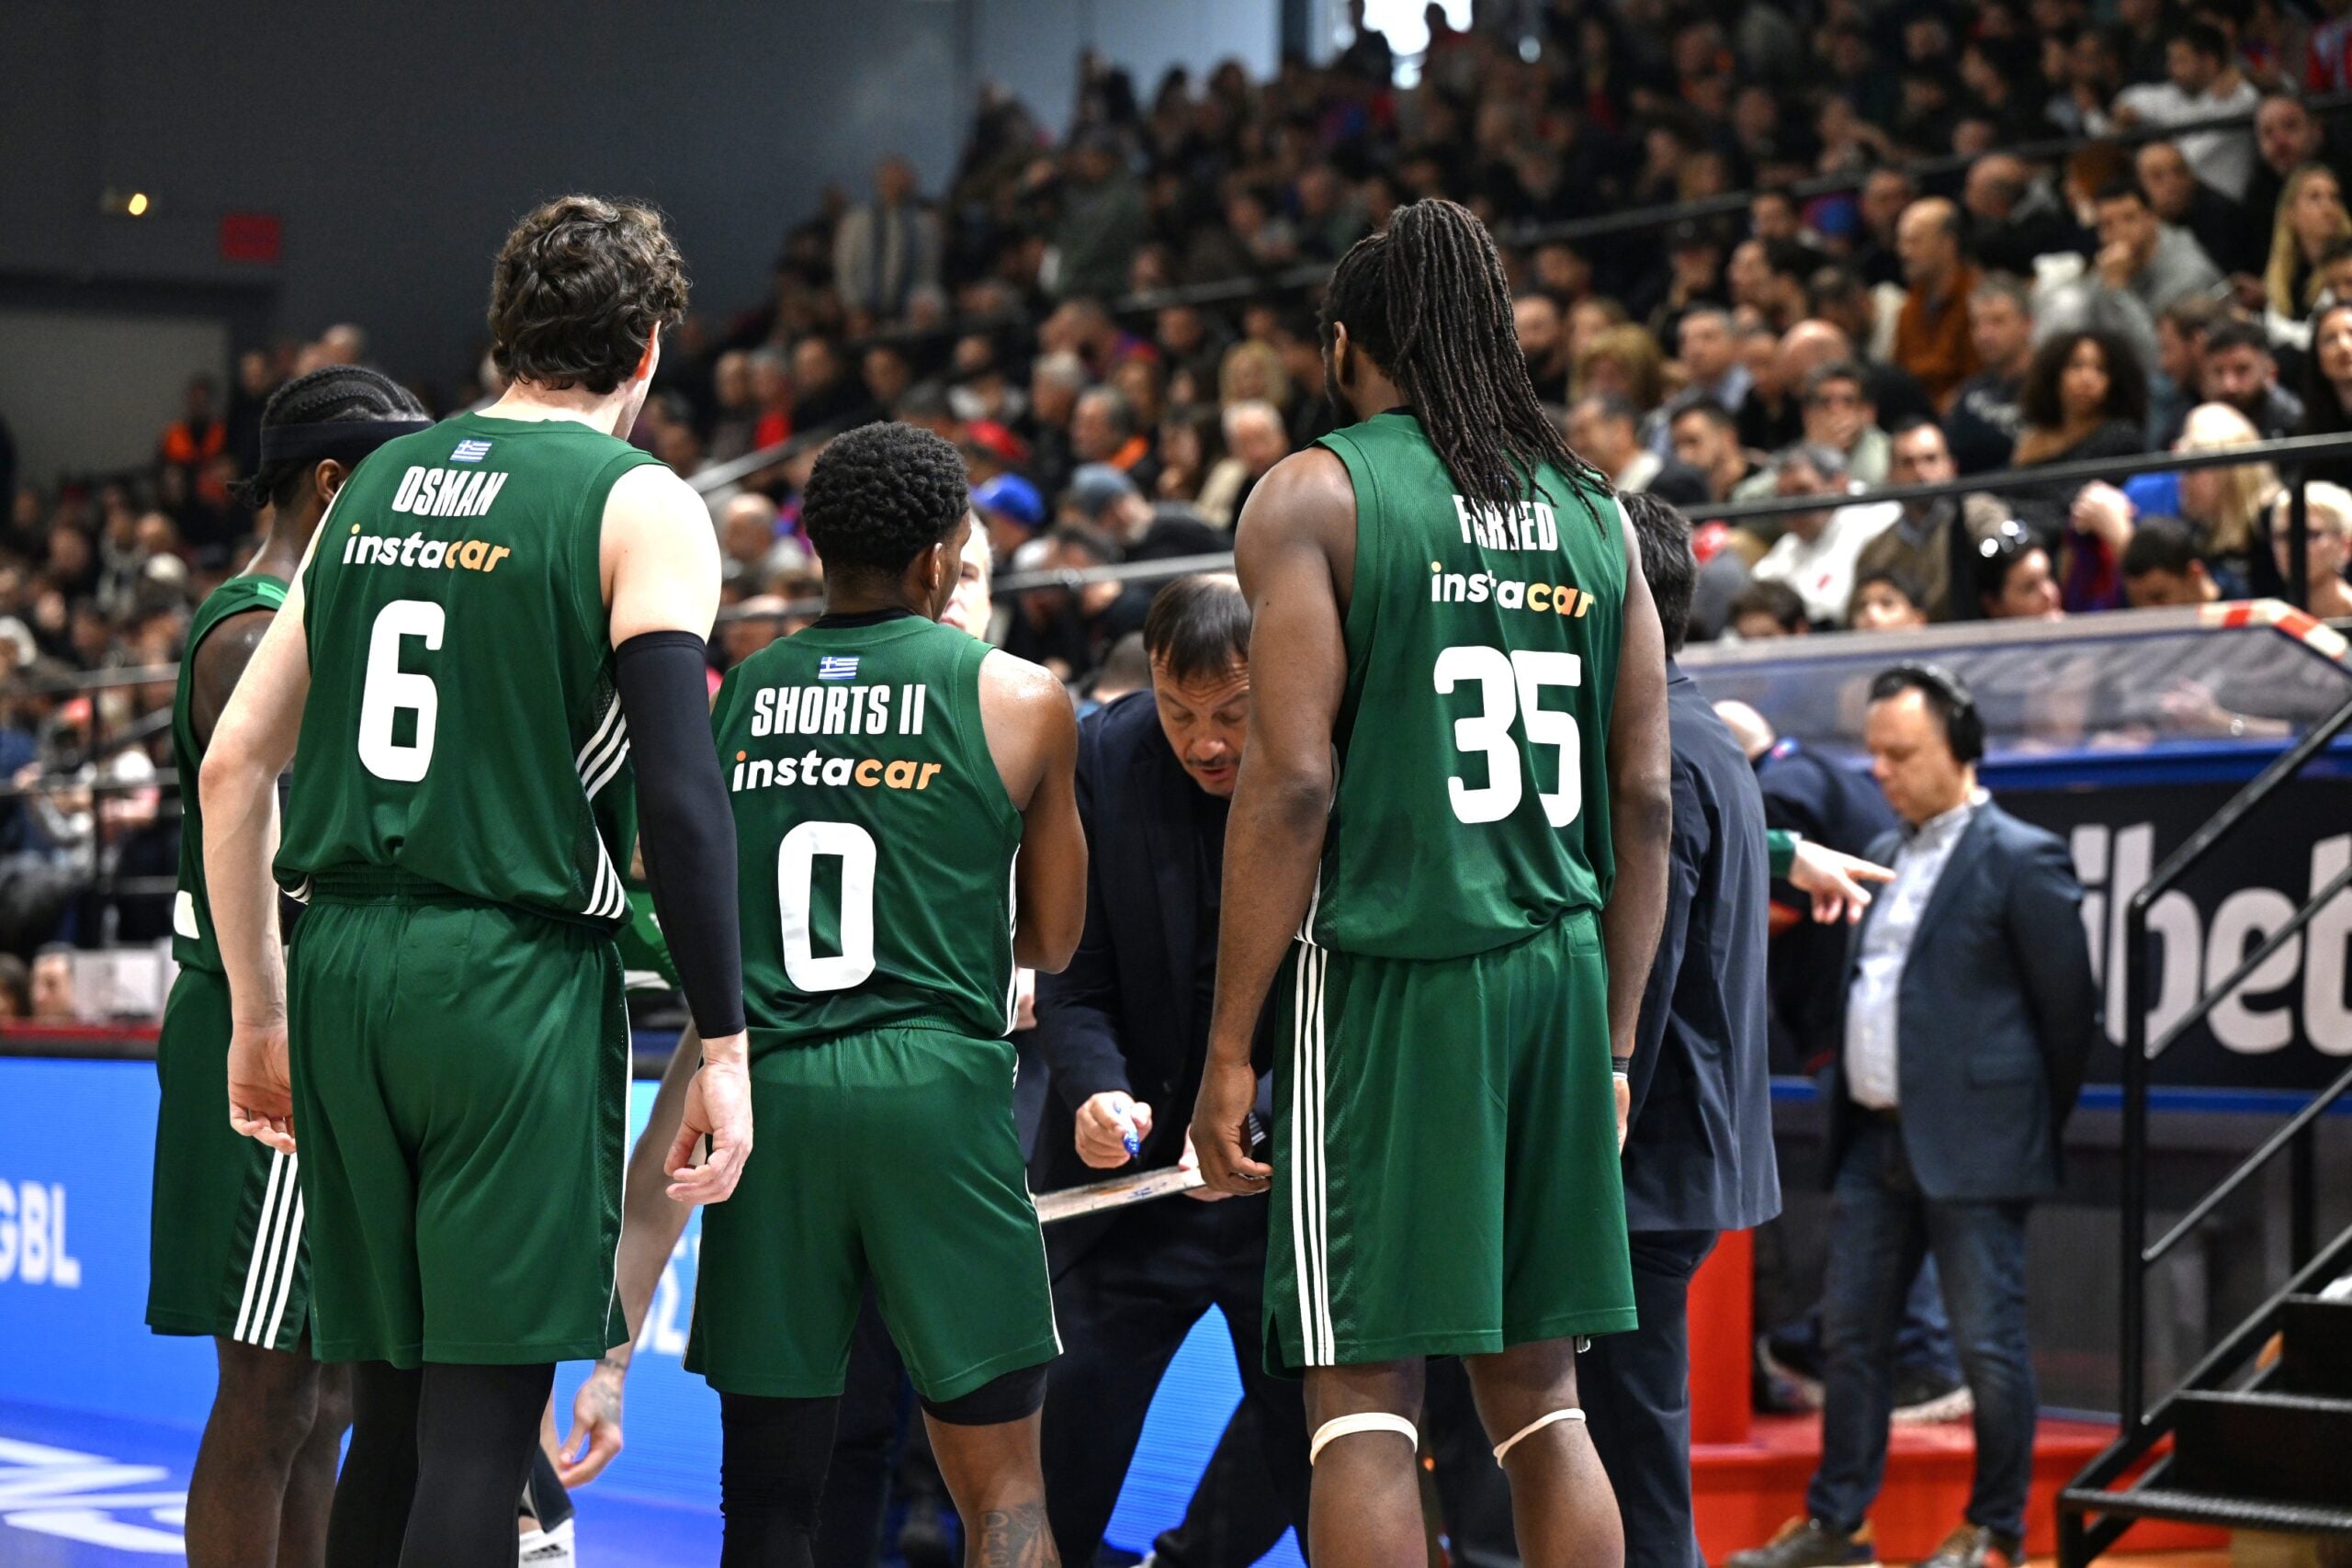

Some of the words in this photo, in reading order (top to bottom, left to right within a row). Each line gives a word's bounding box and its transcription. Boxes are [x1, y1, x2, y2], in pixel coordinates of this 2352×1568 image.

[392, 466, 508, 516] OSMAN
[343, 523, 511, 572] instacar
[357, 599, 446, 783] 6
[752, 683, 889, 736] SHORTS
[899, 683, 926, 735] II
[1433, 645, 1582, 828] 35
[732, 749, 942, 792] instacar
[777, 820, 876, 992] 0
